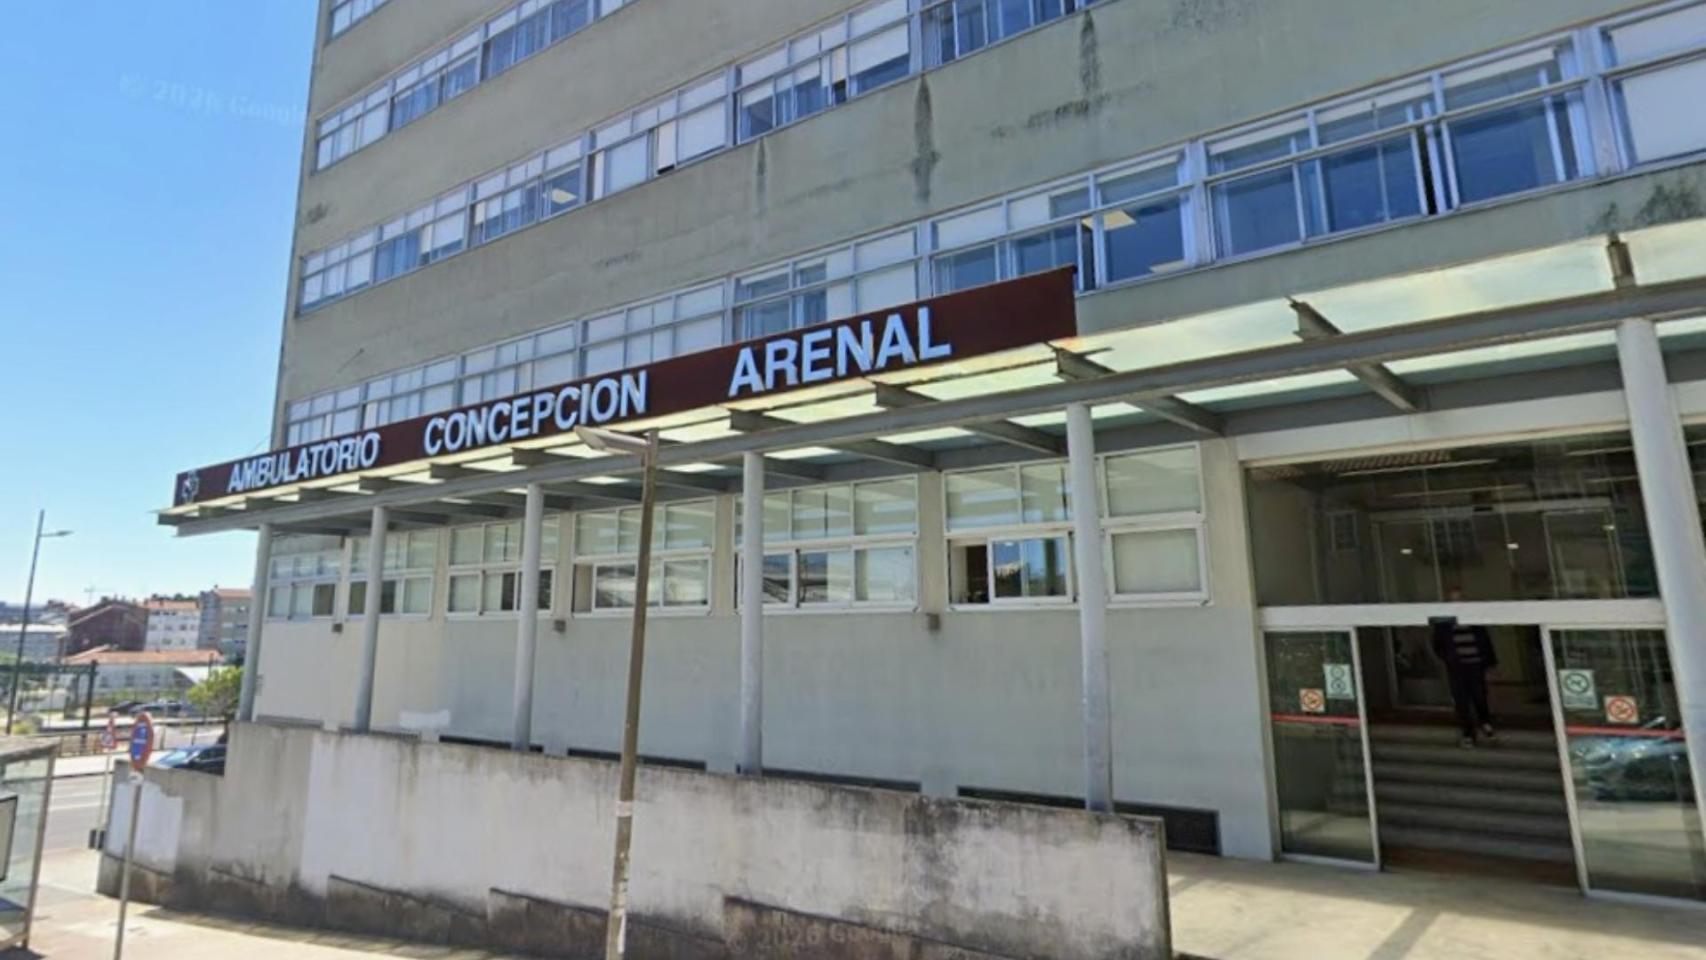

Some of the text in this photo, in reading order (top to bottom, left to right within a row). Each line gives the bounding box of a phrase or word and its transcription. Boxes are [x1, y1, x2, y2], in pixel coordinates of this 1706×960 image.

[227, 306, 952, 493] AMBULATORIO CONCEPCION ARENAL
